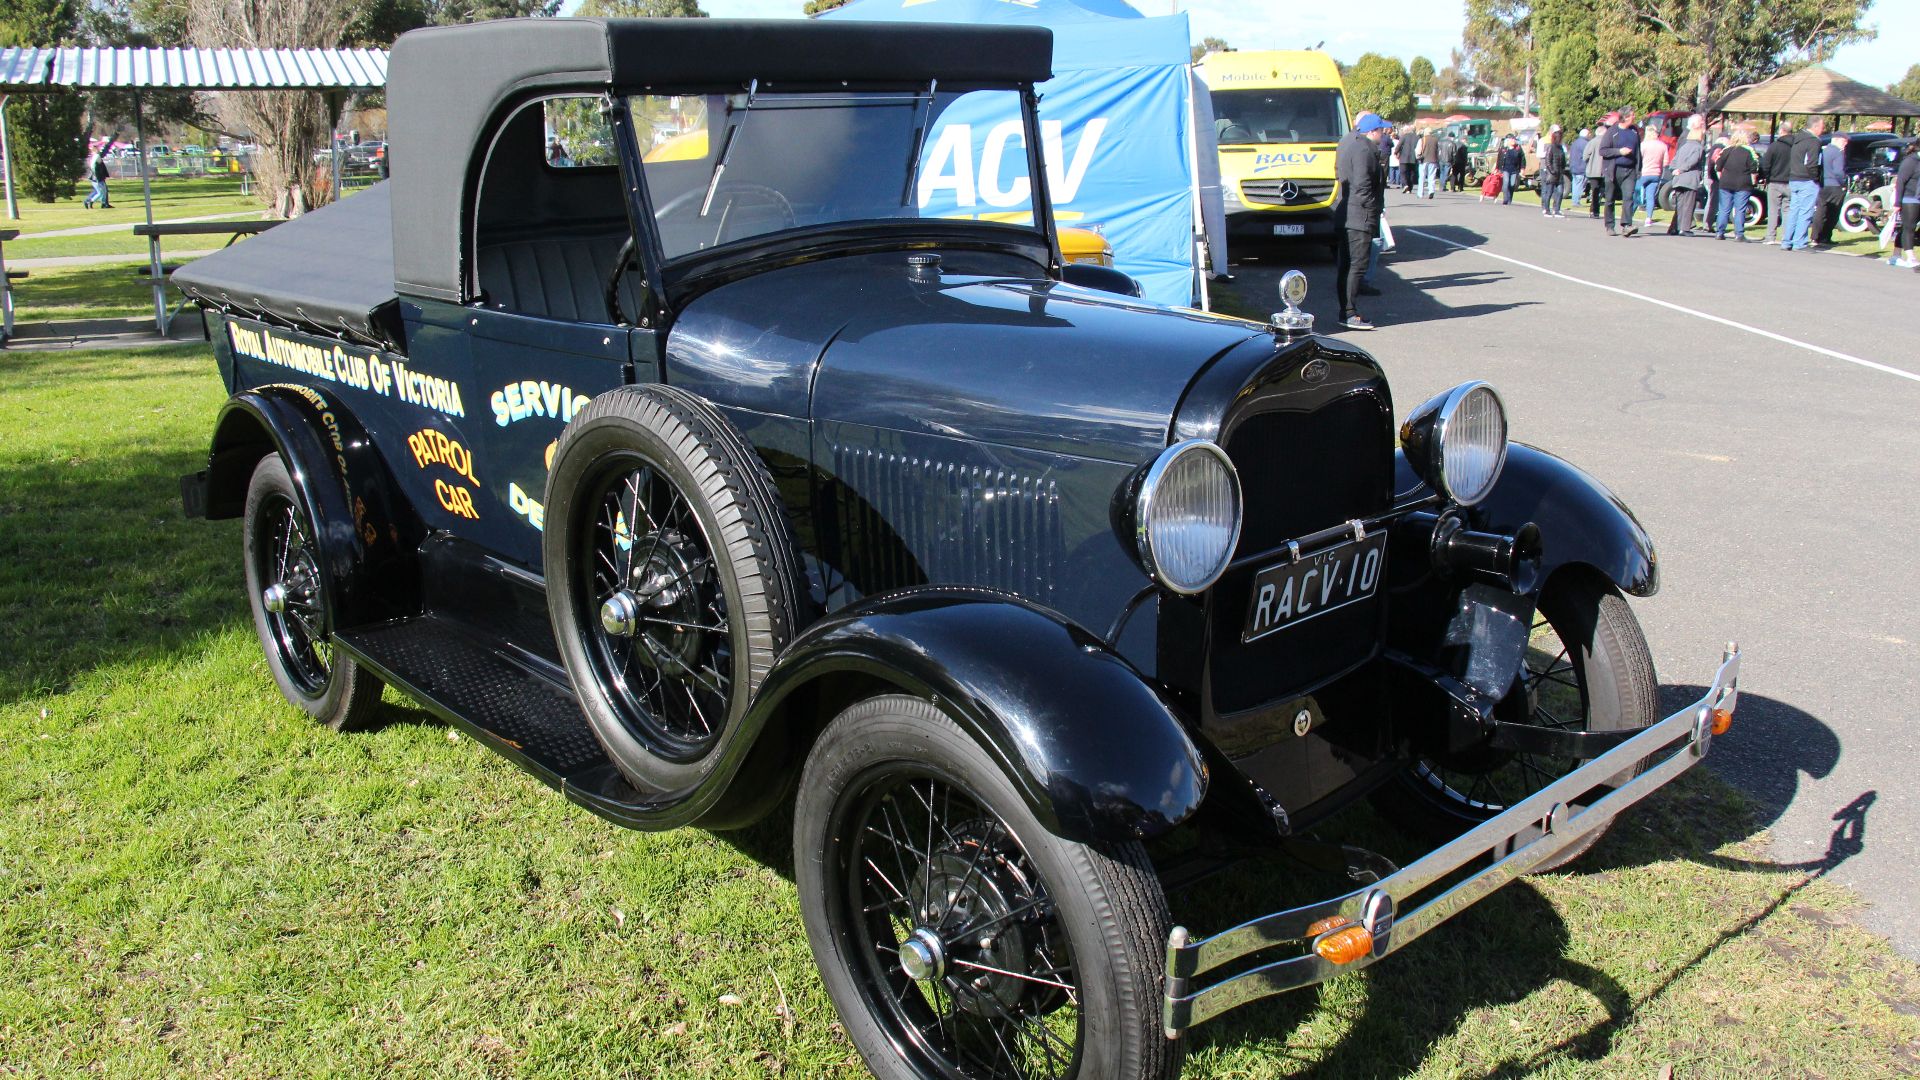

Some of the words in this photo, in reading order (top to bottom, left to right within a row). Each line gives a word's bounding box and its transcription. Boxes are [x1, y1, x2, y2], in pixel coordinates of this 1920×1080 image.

[1222, 71, 1267, 82] Mobile
[1283, 71, 1321, 82] Tyres
[1255, 153, 1318, 165] RACV
[229, 321, 266, 362] ROYAL
[264, 330, 336, 382] AUTOMOBILE
[332, 345, 370, 391] CLUB
[369, 354, 392, 397] OF
[392, 360, 465, 418] VICTORIA
[407, 428, 481, 488] PATROL
[434, 478, 480, 520] CAR
[1314, 551, 1336, 566] VIC
